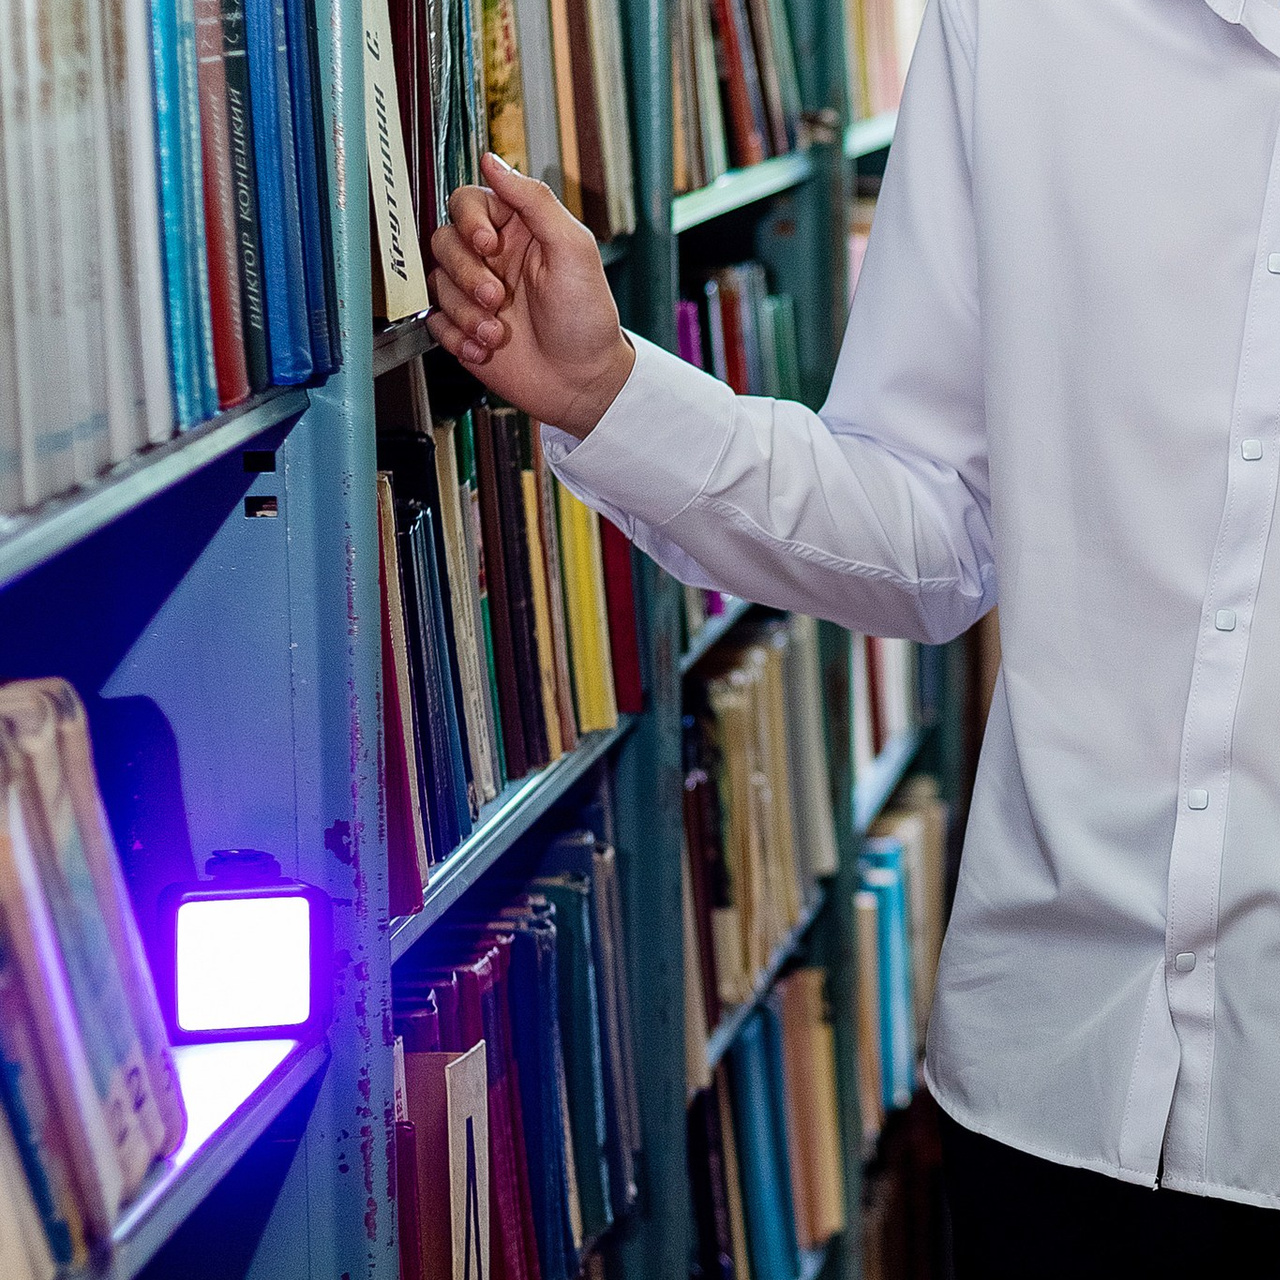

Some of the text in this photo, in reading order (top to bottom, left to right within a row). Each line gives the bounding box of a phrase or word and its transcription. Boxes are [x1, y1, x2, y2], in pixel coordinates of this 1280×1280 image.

[227, 86, 263, 332] ВИКТОР КОНЕЦКИЙ
[373, 82, 408, 282] Крутилин
